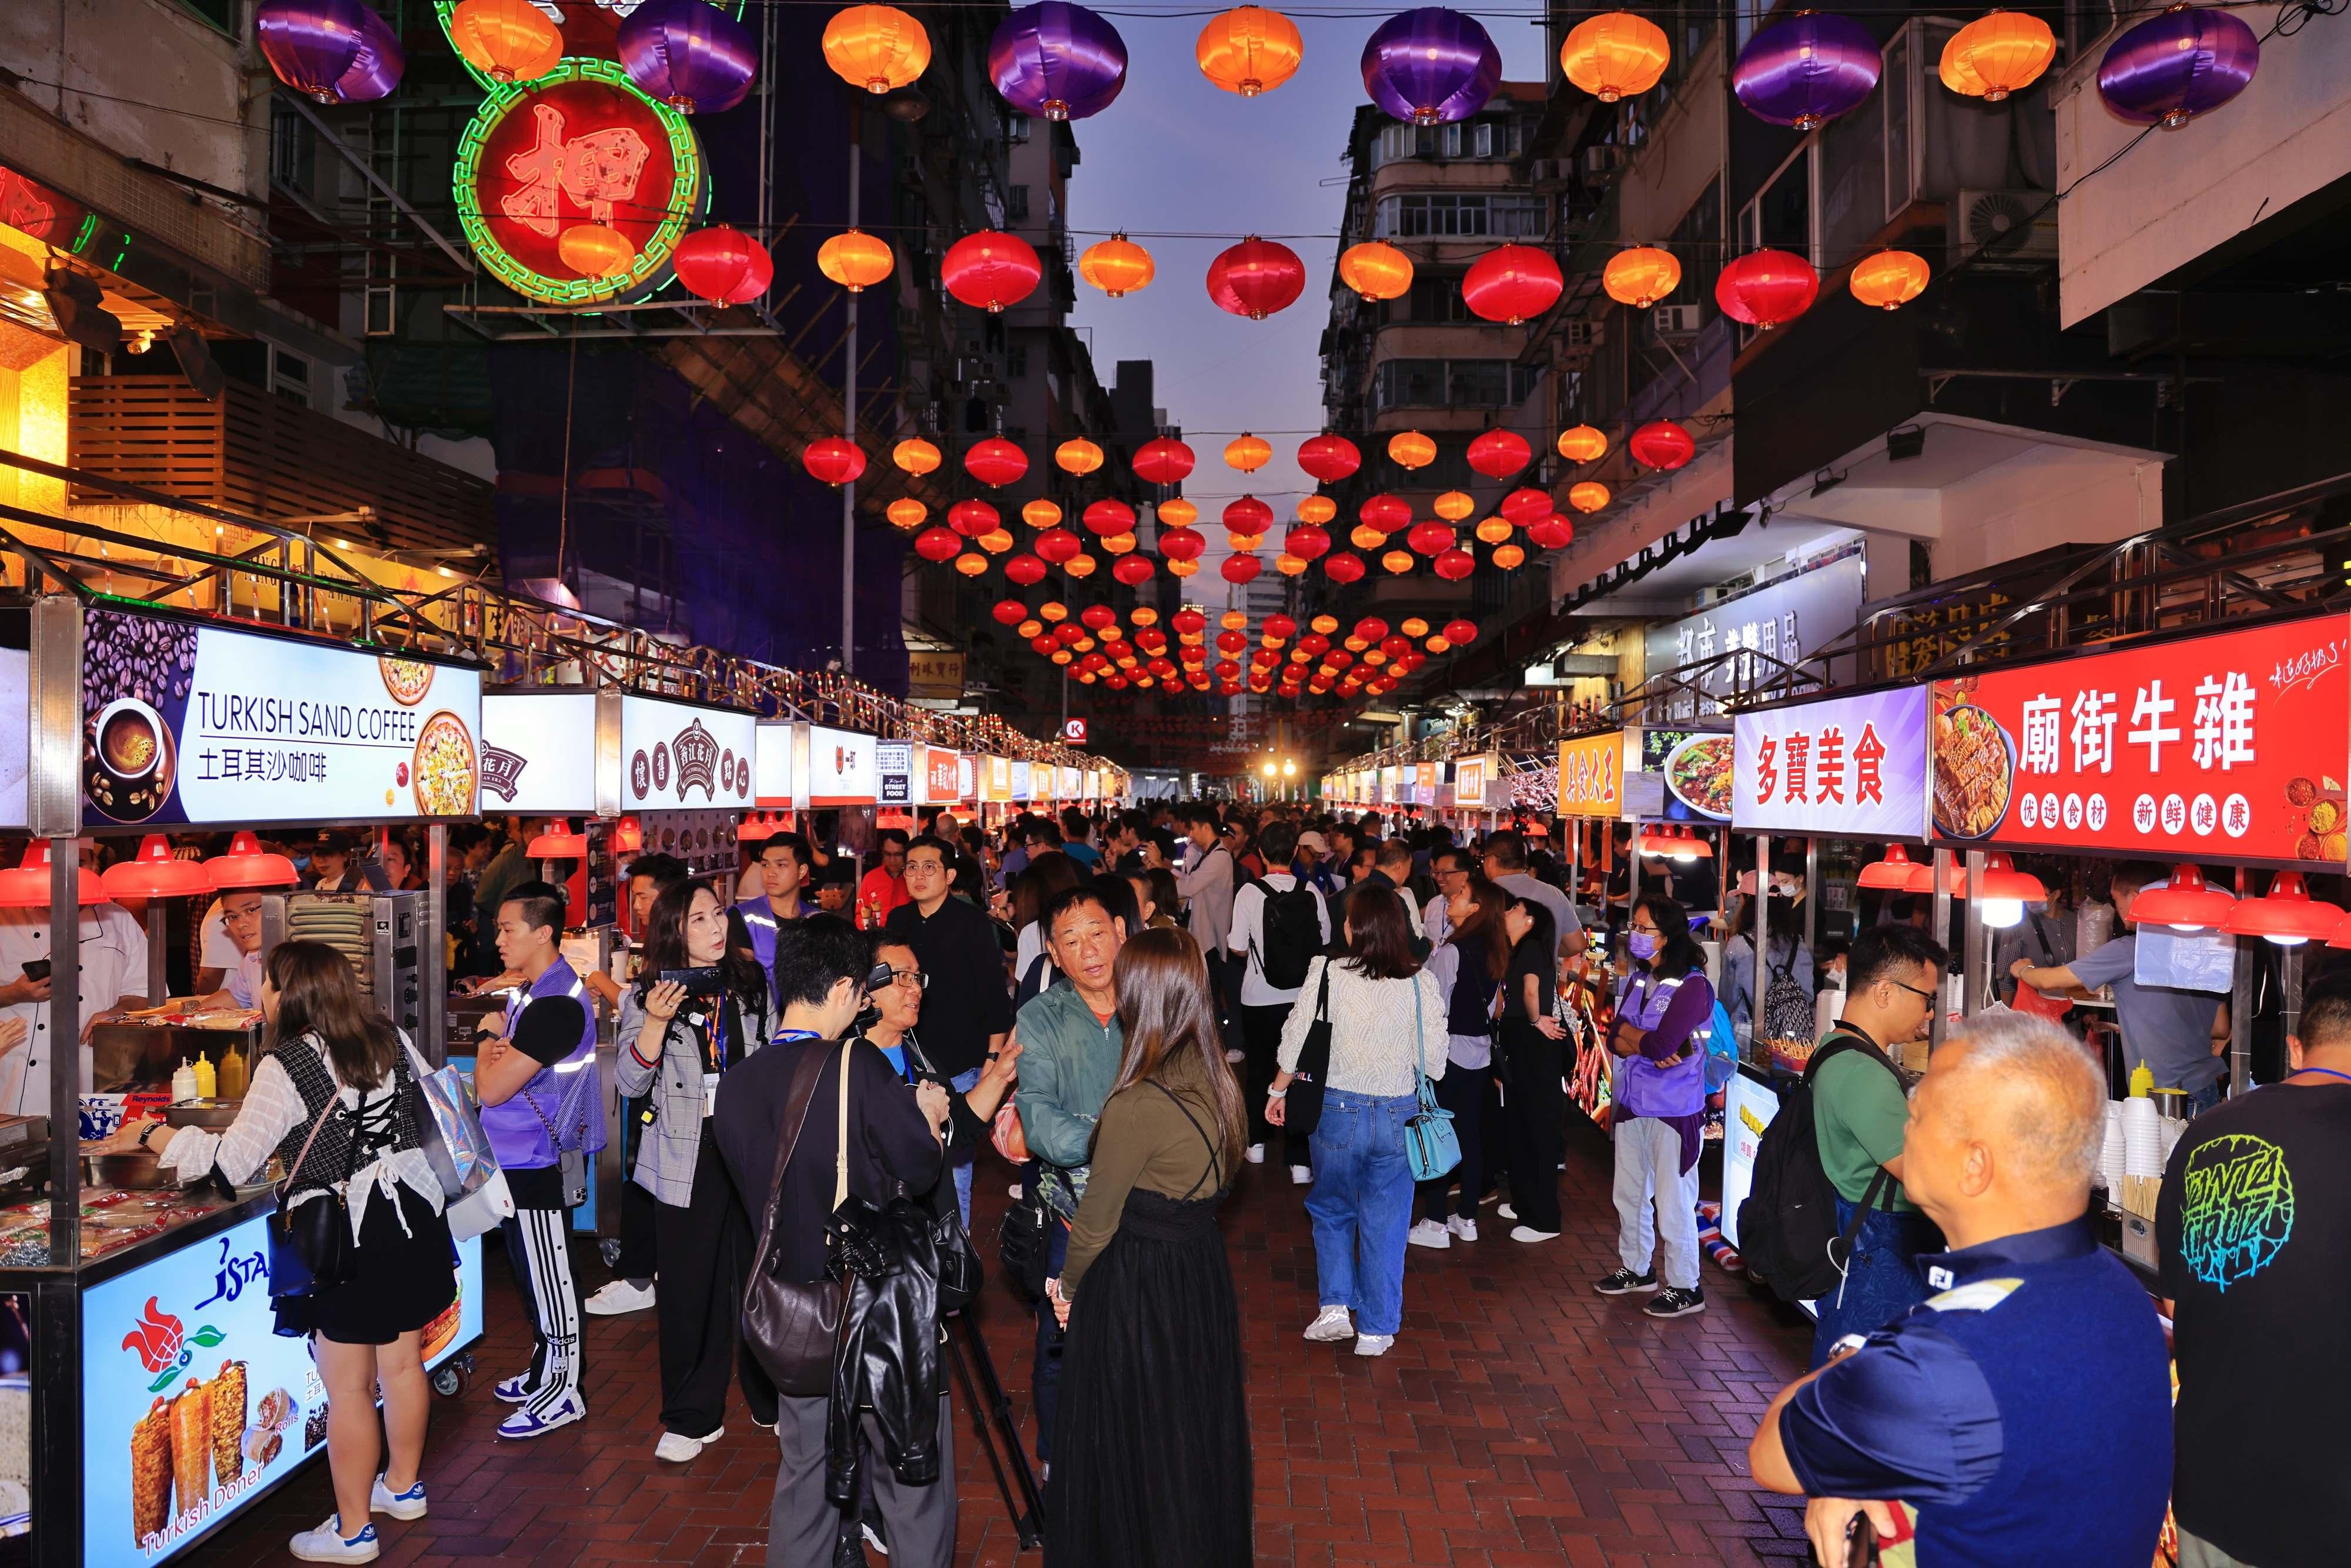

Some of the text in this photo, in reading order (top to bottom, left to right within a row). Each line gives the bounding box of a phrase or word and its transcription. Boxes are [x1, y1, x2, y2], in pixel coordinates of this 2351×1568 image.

[501, 104, 650, 238] 押
[198, 692, 416, 742] TURKISH SAND COFFEE
[1071, 724, 1081, 735] K
[2020, 671, 2256, 774] 廟街牛雜
[197, 748, 327, 783] 土耳其沙咖啡
[680, 743, 713, 769] 香江花月
[1757, 720, 1887, 806] 多寶美食
[1566, 746, 1614, 805] 美食大王
[2023, 797, 2246, 831] 优选食材 新鲜健康
[132, 1095, 170, 1104] Reynolds
[1928, 1265, 1954, 1290] FJ
[547, 1336, 575, 1345] adidas
[275, 1414, 299, 1436] Rolls
[142, 1463, 265, 1560] Turkish Doner
